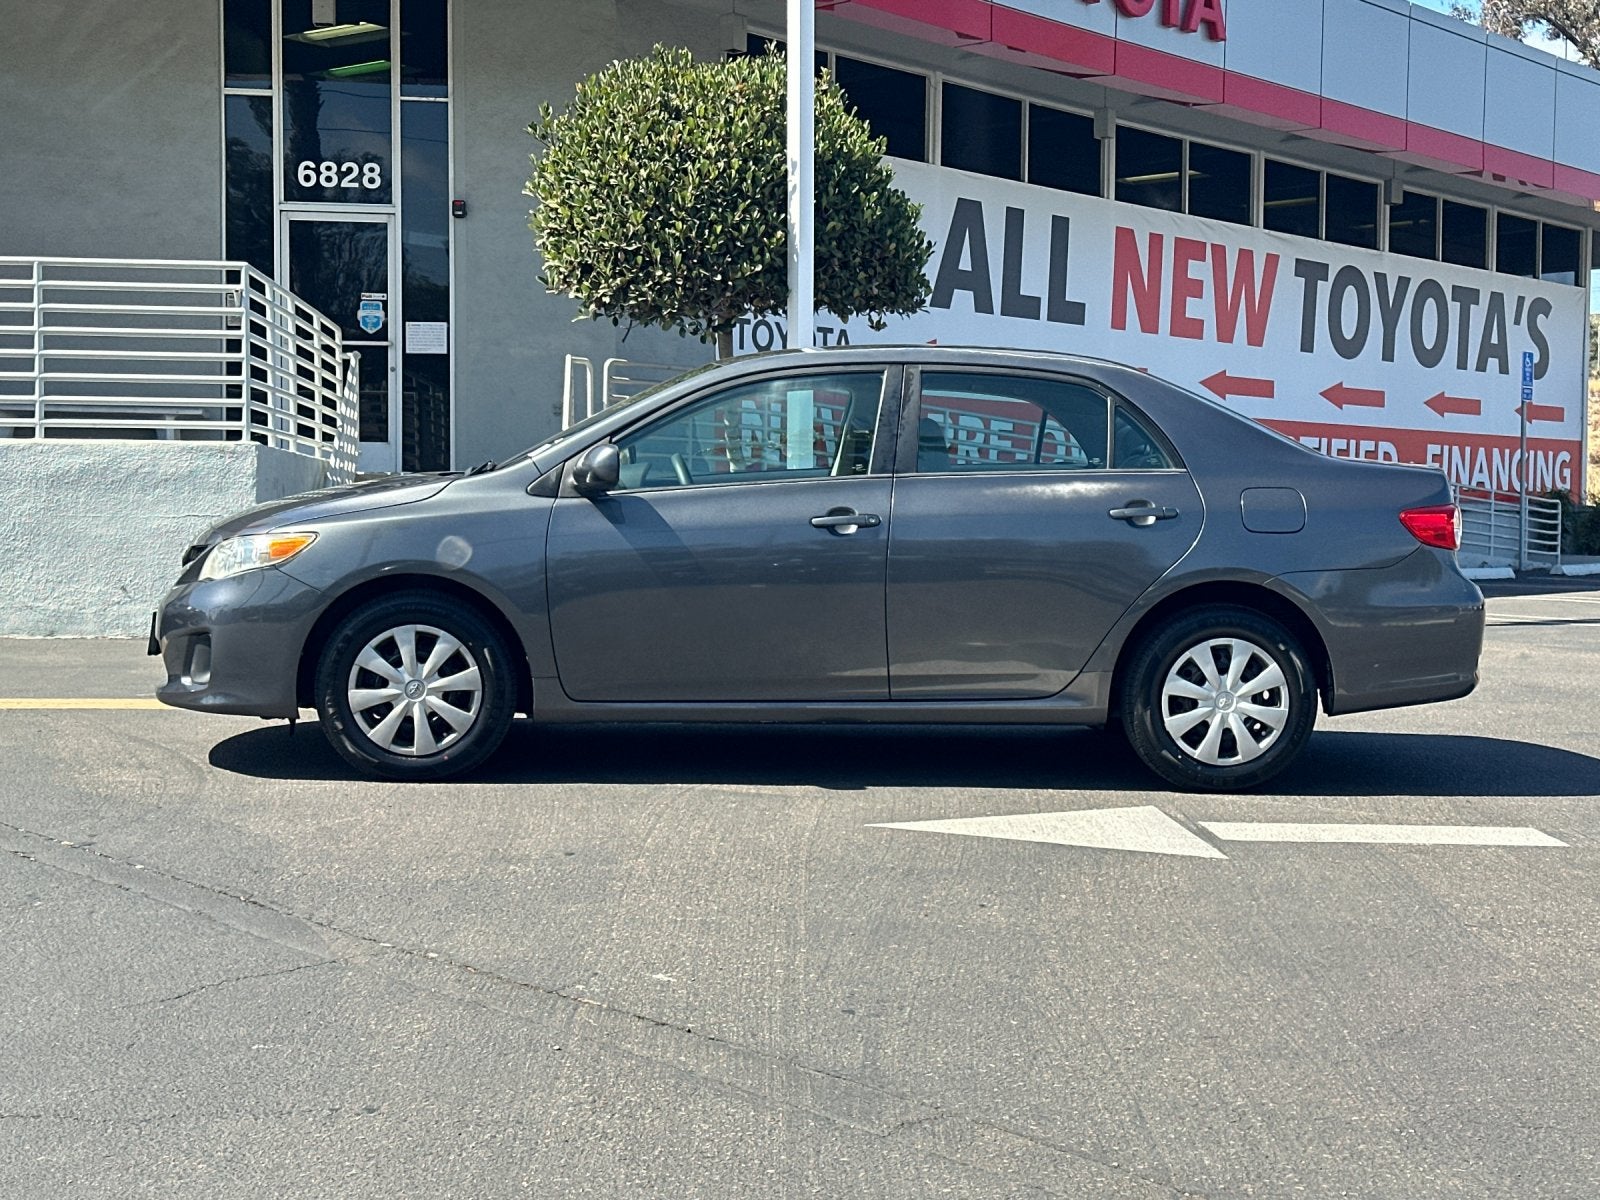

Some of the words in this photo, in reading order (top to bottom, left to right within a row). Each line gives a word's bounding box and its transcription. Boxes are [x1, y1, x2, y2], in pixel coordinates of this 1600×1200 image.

[297, 160, 382, 190] 6828
[929, 196, 1087, 326] ALL
[1110, 225, 1281, 348] NEW
[1294, 257, 1553, 381] TOYOTA'S
